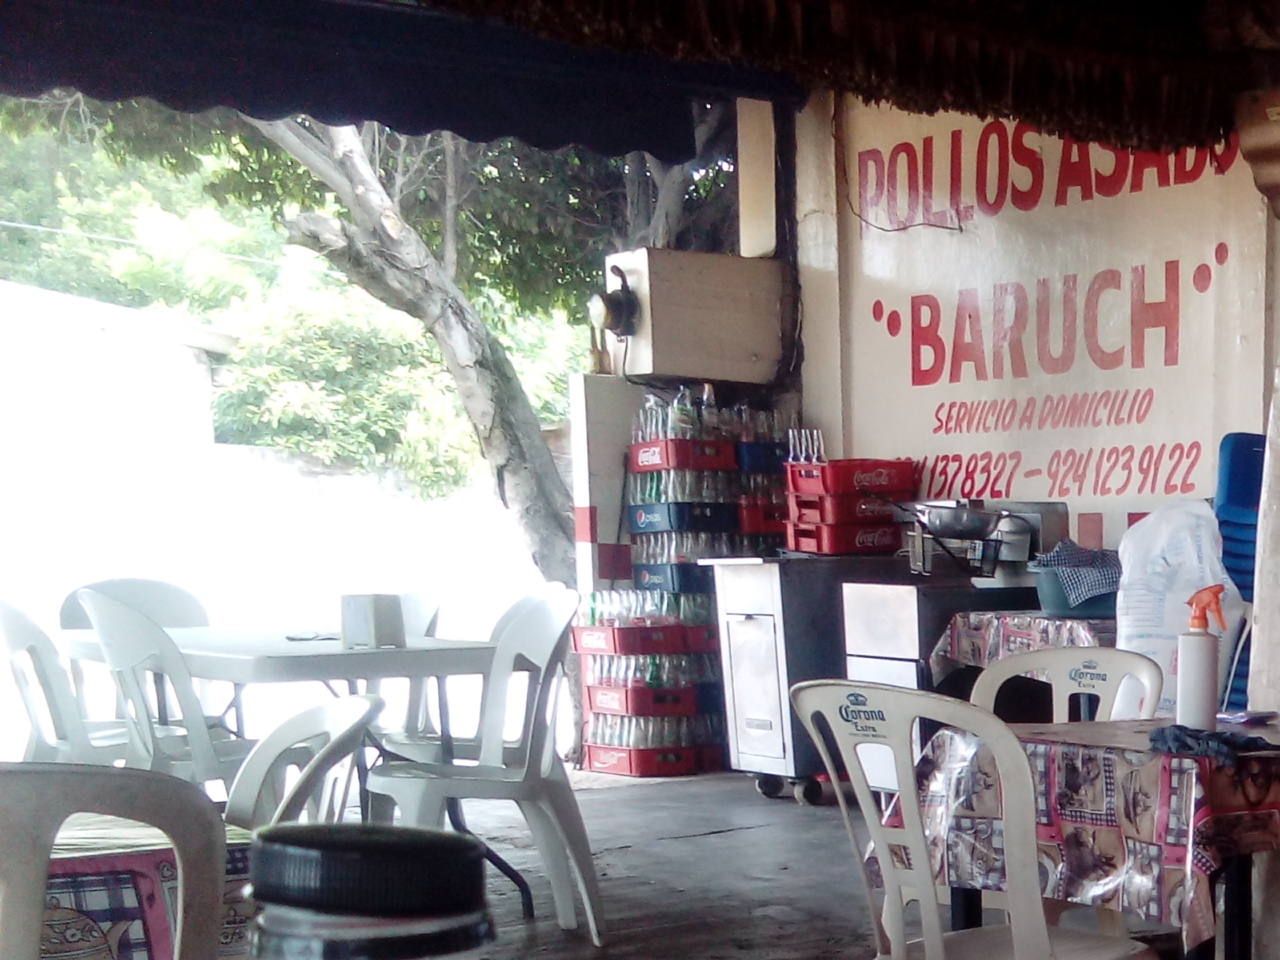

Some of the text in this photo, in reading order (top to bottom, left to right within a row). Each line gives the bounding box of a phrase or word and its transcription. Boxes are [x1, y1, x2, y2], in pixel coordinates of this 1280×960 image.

[858, 120, 1044, 238] POLLOS
[911, 260, 1180, 387] BARUCH
[932, 387, 1154, 436] SERVICIO A DOMICILIO
[838, 704, 886, 723] Corona
